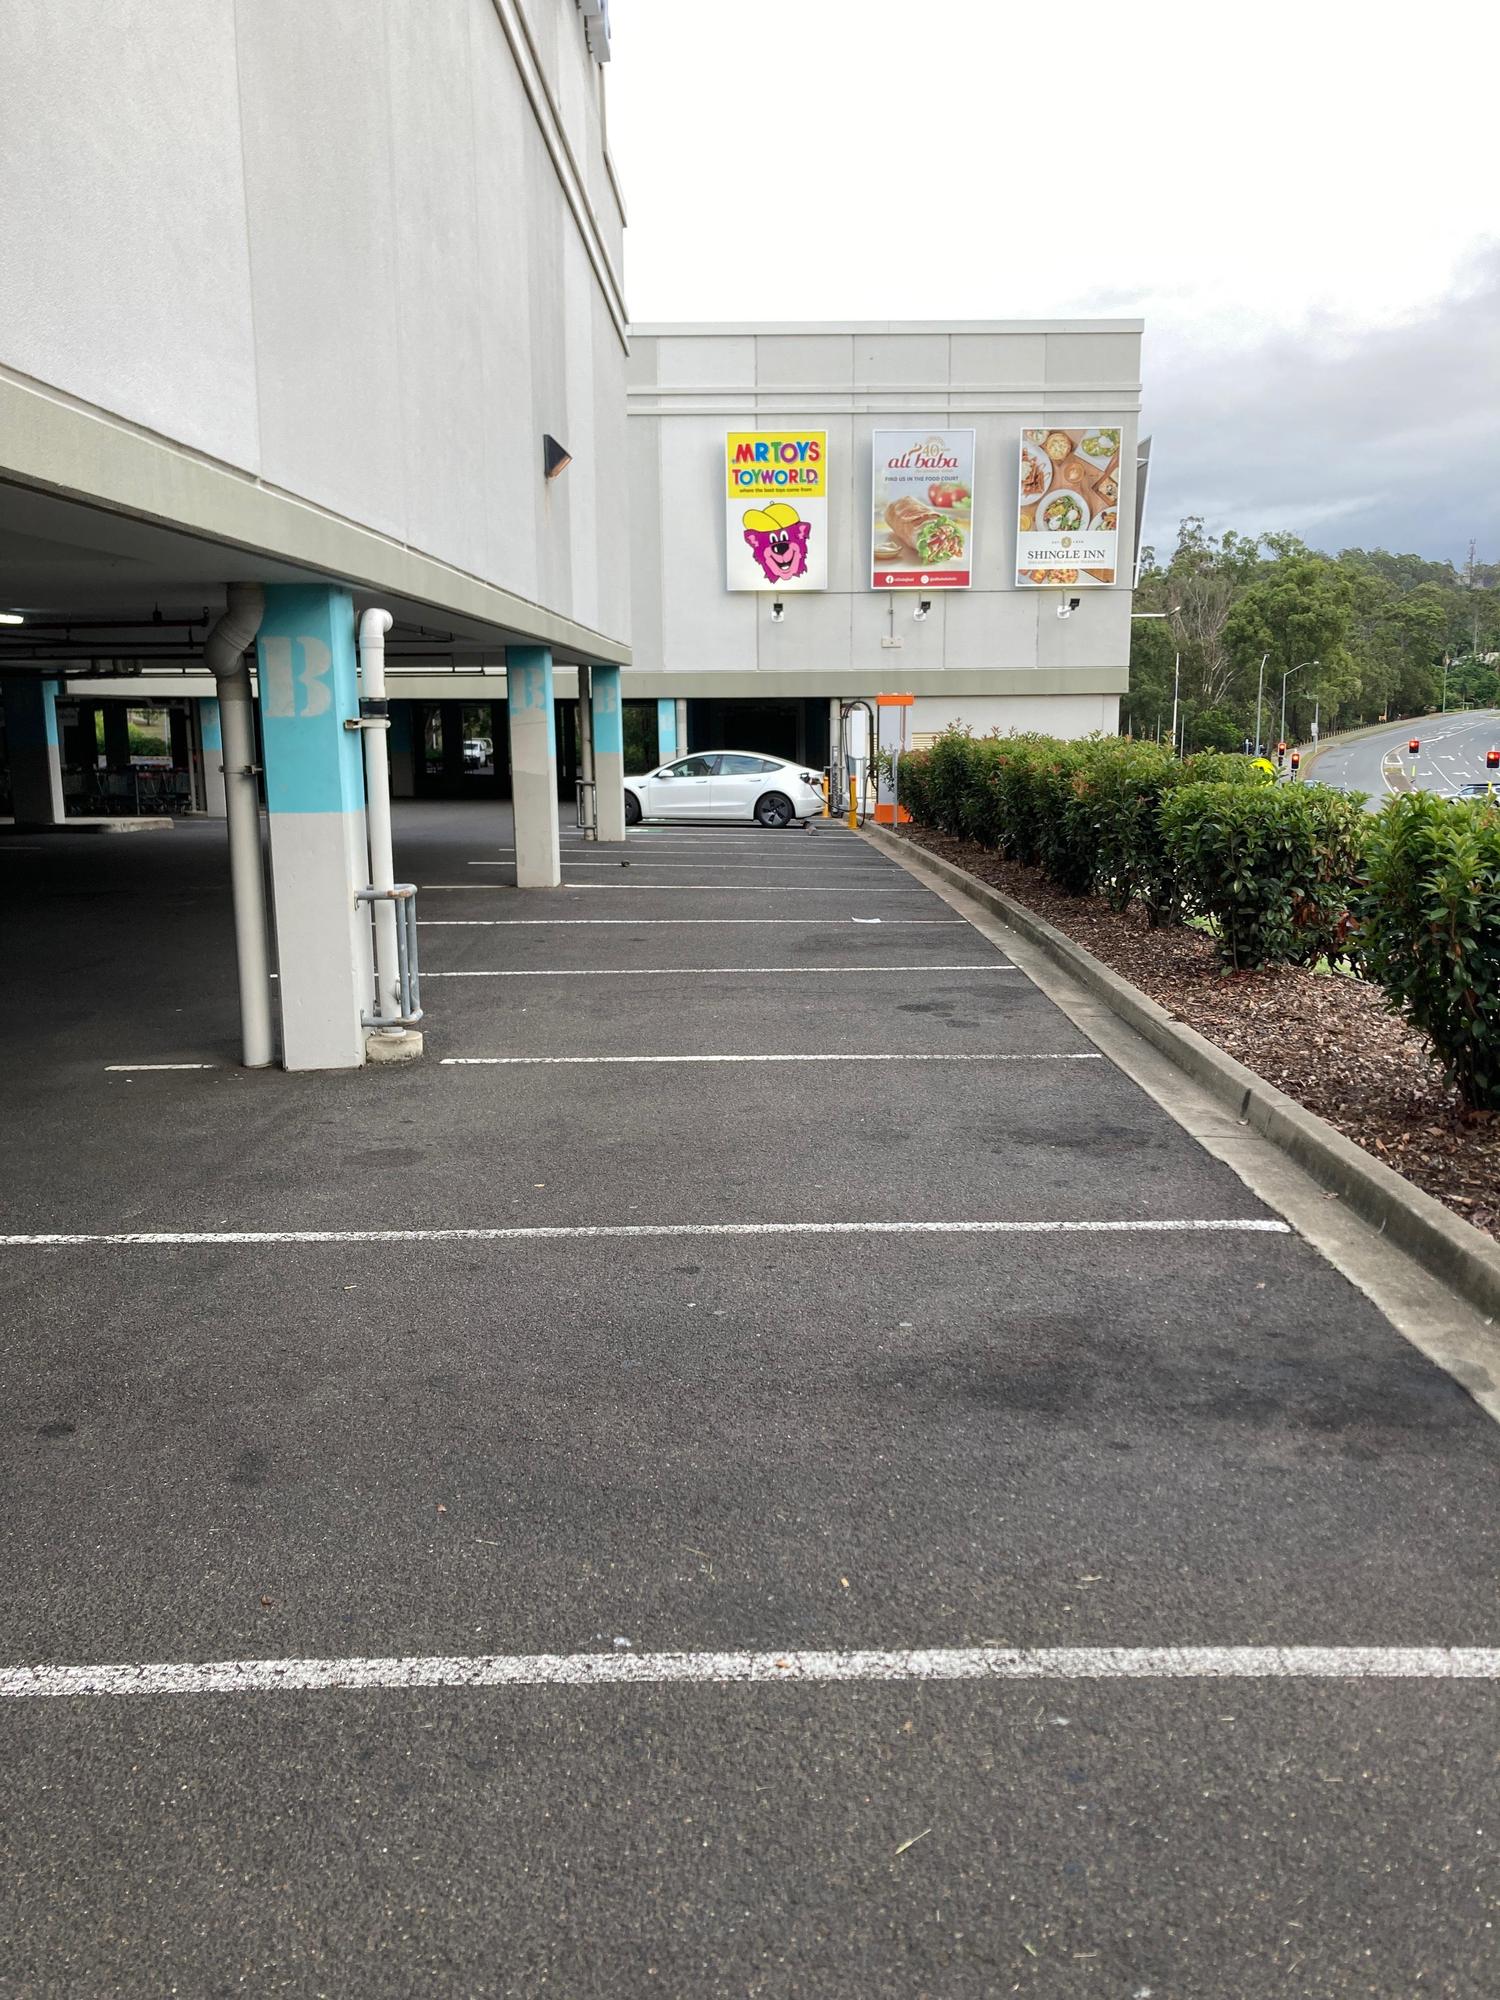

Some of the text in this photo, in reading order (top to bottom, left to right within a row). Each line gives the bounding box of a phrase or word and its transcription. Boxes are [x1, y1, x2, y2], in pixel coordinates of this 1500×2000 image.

[736, 441, 820, 464] MR TOYS
[888, 453, 959, 468] ali baba
[732, 468, 818, 485] TOYWORLD
[1027, 550, 1105, 560] SHINGLE INN
[261, 636, 332, 718] B
[511, 667, 546, 710] B
[592, 685, 617, 713] B
